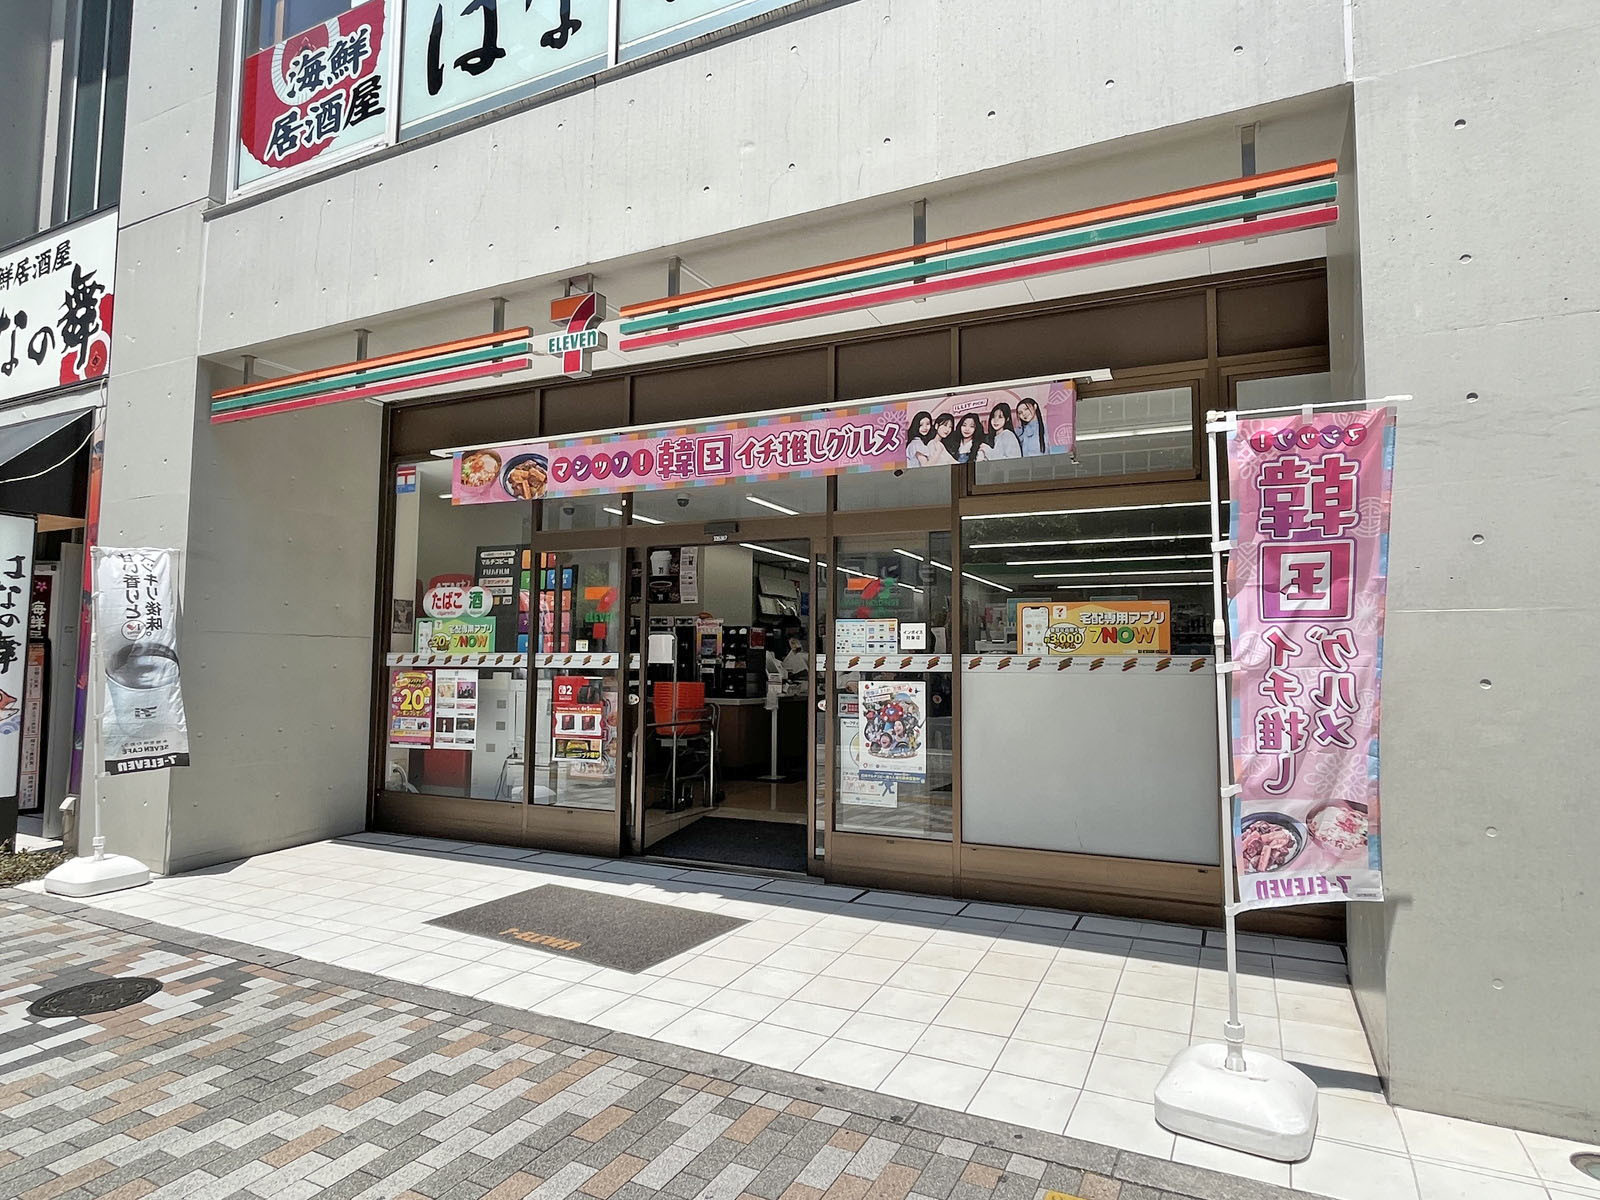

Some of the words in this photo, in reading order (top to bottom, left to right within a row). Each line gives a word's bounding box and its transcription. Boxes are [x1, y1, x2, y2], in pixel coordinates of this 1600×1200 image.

[289, 28, 369, 98] 海鮮
[267, 74, 386, 157] 居酒屋
[551, 292, 597, 373] 7
[432, 592, 463, 610] たばこ
[468, 591, 483, 609] 酒
[1080, 611, 1166, 625] 宅配専用アプリ
[453, 635, 488, 648] 7NOW
[1088, 626, 1156, 644] 7NOW
